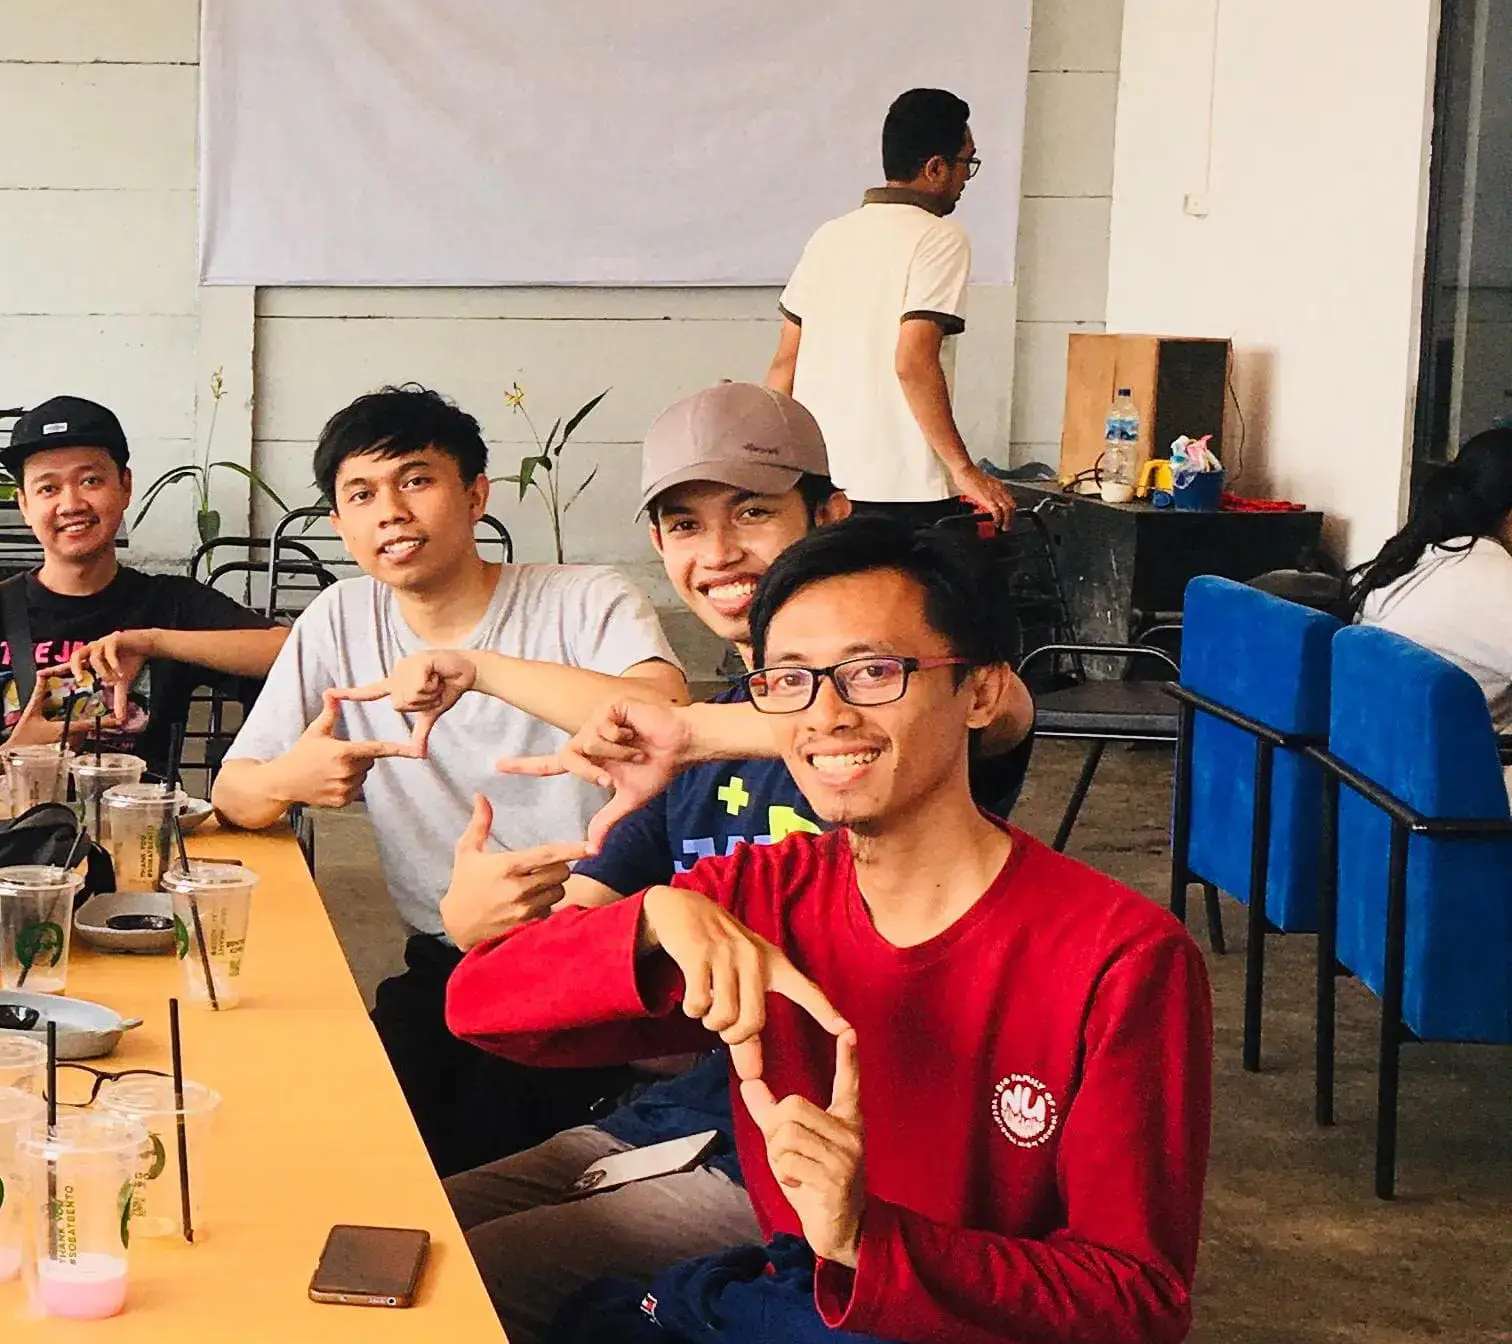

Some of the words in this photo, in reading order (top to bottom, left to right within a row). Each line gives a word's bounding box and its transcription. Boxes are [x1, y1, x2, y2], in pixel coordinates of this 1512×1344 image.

[1001, 1084, 1046, 1122] NU
[64, 1185, 77, 1265] #SOBATBENTO
[58, 1227, 67, 1264] THANK
